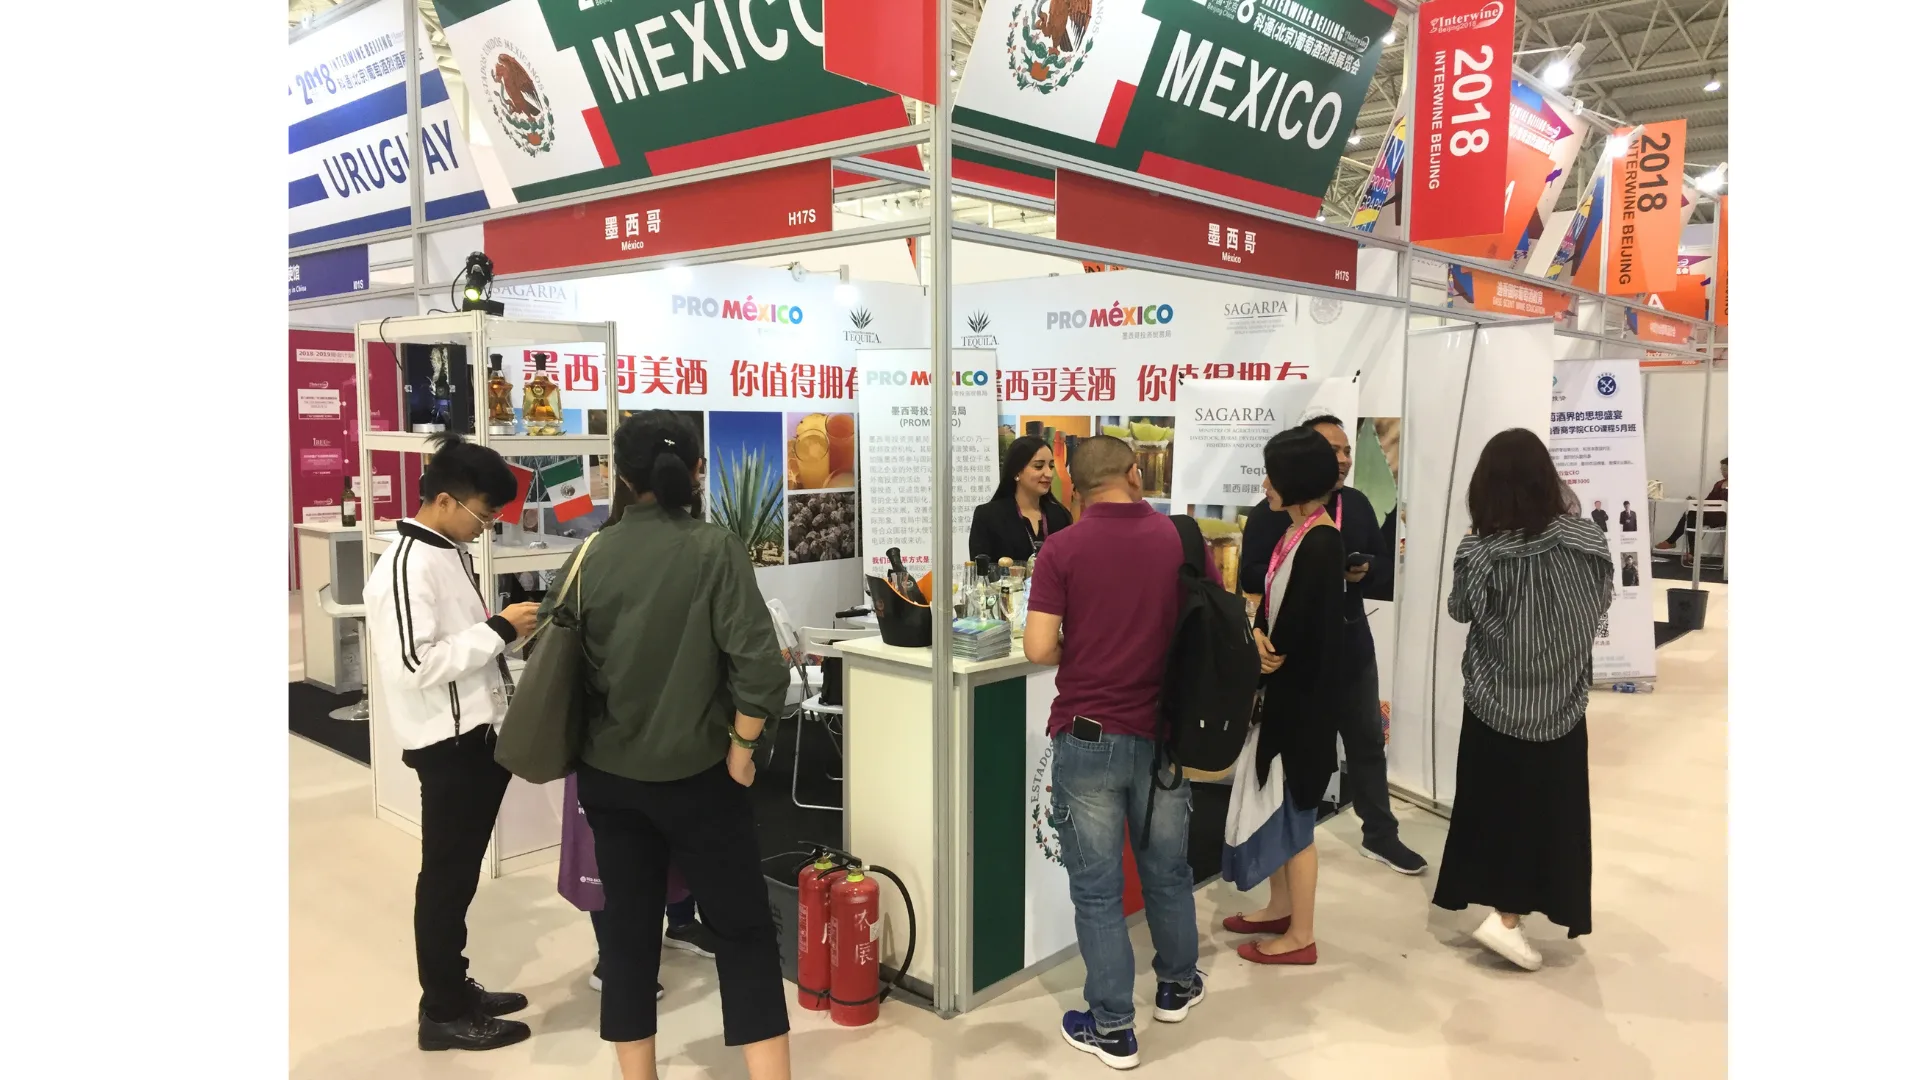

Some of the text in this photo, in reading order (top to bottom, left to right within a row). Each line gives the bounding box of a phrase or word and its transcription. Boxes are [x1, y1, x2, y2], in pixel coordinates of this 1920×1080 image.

[1311, 12, 1345, 41] BEIJING
[1439, 8, 1499, 27] Interwine
[364, 34, 393, 57] BEIJING
[1253, 12, 1361, 76] 科通(北京)葡萄酒烈酒展览会
[295, 63, 337, 105] 2018
[1156, 29, 1342, 150] MEXICO
[1450, 44, 1494, 157] 2018
[1428, 50, 1446, 190] INTERWINE BEIJING
[1637, 132, 1671, 213] 2018
[788, 208, 816, 226] H17S
[1619, 139, 1640, 285] NTERWINE BEIJING
[605, 209, 661, 240] 墨西哥
[621, 240, 644, 250] México
[1208, 222, 1256, 254] 墨西哥
[1222, 251, 1242, 264] México
[1334, 269, 1350, 282] H17S
[671, 295, 719, 318] PRO
[1224, 300, 1288, 316] SAGARPA
[1046, 309, 1087, 330] PRO
[866, 370, 989, 387] PRO MICO
[997, 366, 1117, 402] 西哥美酒
[891, 406, 967, 416] 墨西哥投易局
[1194, 407, 1276, 422] SAGARPA
[1550, 424, 1637, 435] 香商学院CEO课程5月班
